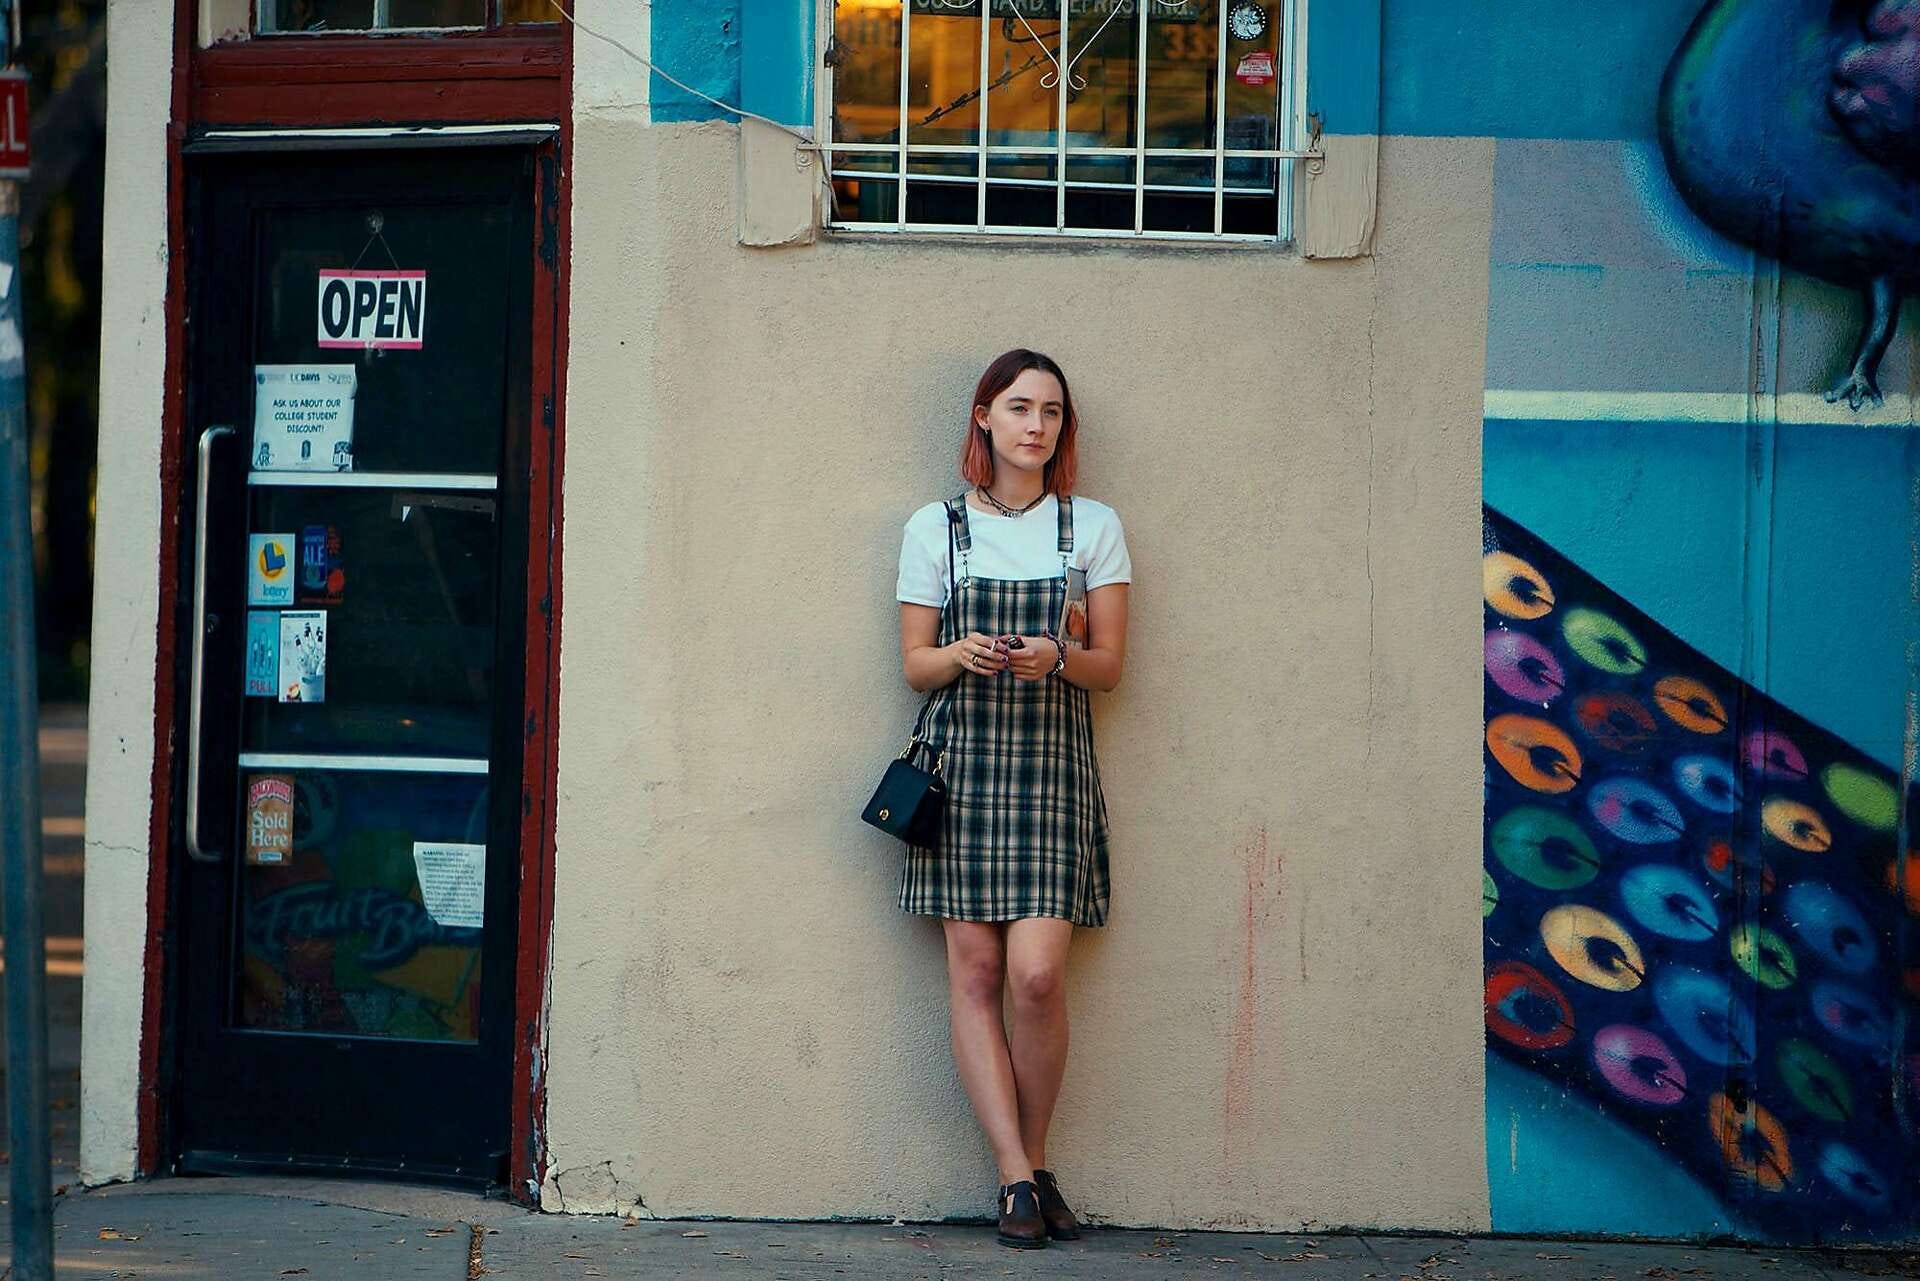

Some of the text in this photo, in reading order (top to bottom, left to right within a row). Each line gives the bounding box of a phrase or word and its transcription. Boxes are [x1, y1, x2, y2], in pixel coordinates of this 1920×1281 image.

[0, 94, 26, 151] L
[321, 279, 422, 339] OPEN
[272, 399, 341, 408] ASK US ABOUT OUR
[274, 411, 338, 421] COLLEGE STUDENT
[287, 424, 325, 434] DISCOUNT!
[261, 584, 289, 599] lottery
[250, 679, 272, 691] PULL
[252, 810, 288, 829] Sold
[251, 828, 288, 847] Here
[254, 880, 382, 950] Fruit
